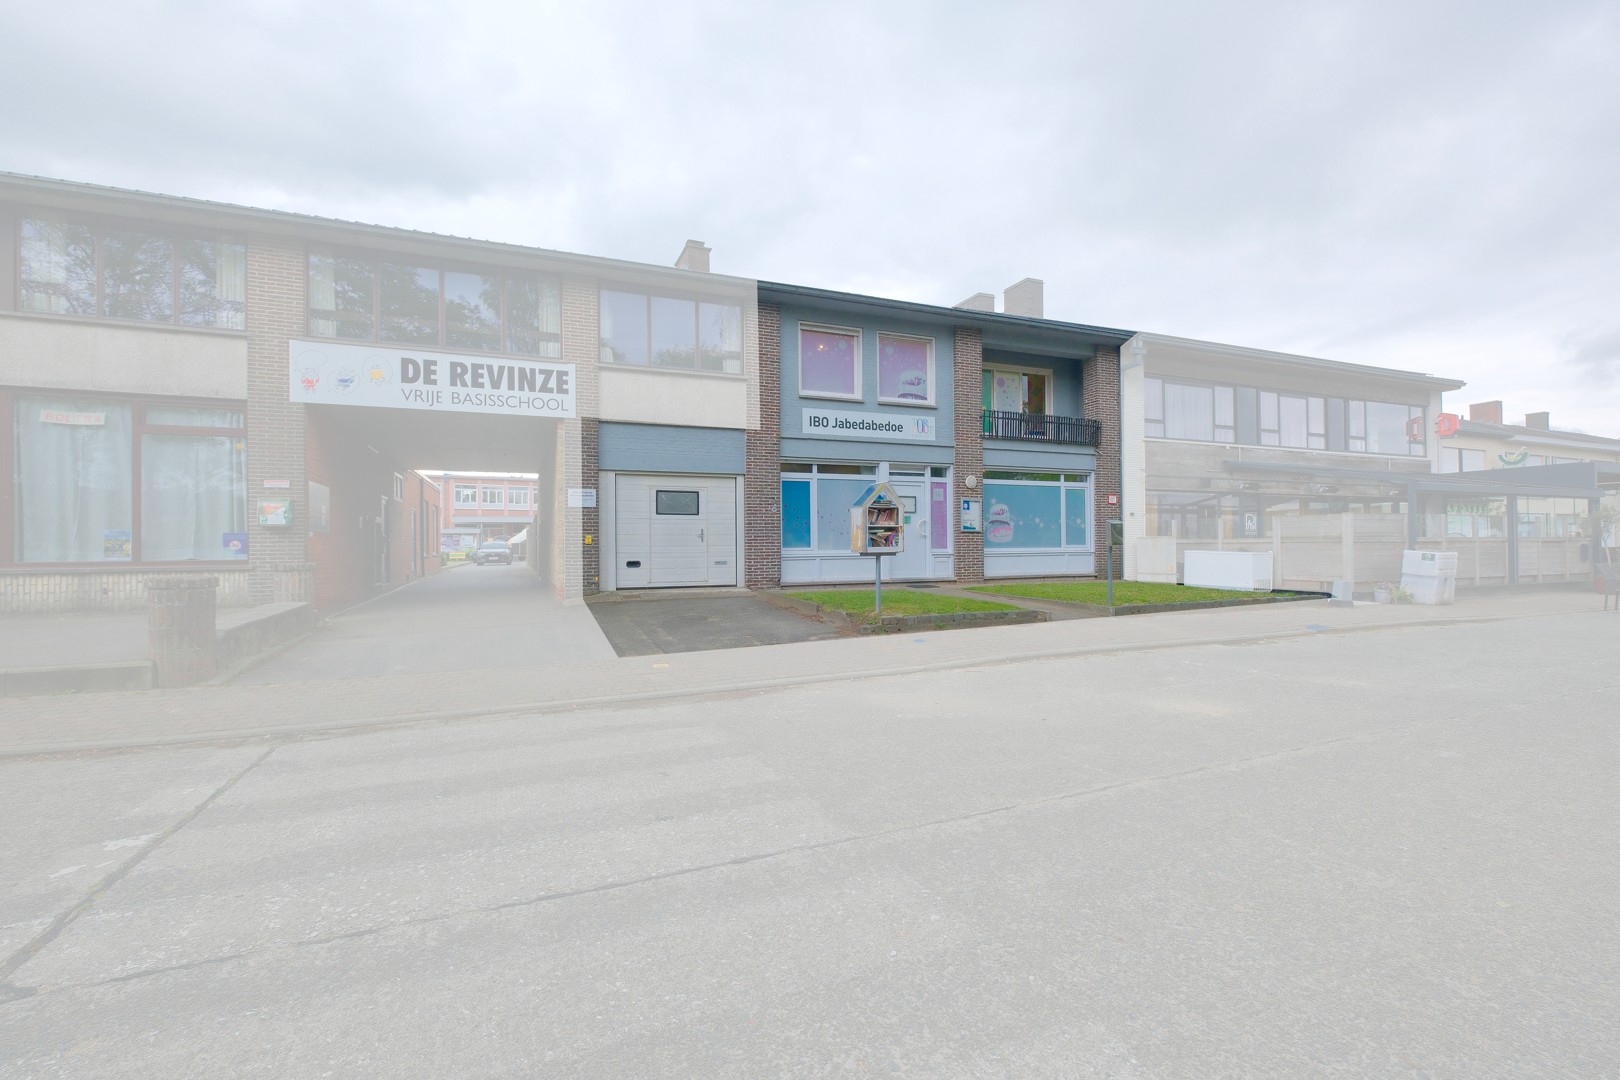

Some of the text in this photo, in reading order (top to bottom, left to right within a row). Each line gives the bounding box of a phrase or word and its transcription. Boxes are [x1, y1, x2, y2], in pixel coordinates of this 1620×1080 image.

[400, 357, 570, 395] DE REVINZE
[401, 388, 569, 412] VRIJE BASISSCHOOL
[809, 415, 904, 433] IBO Jabedabedoe
